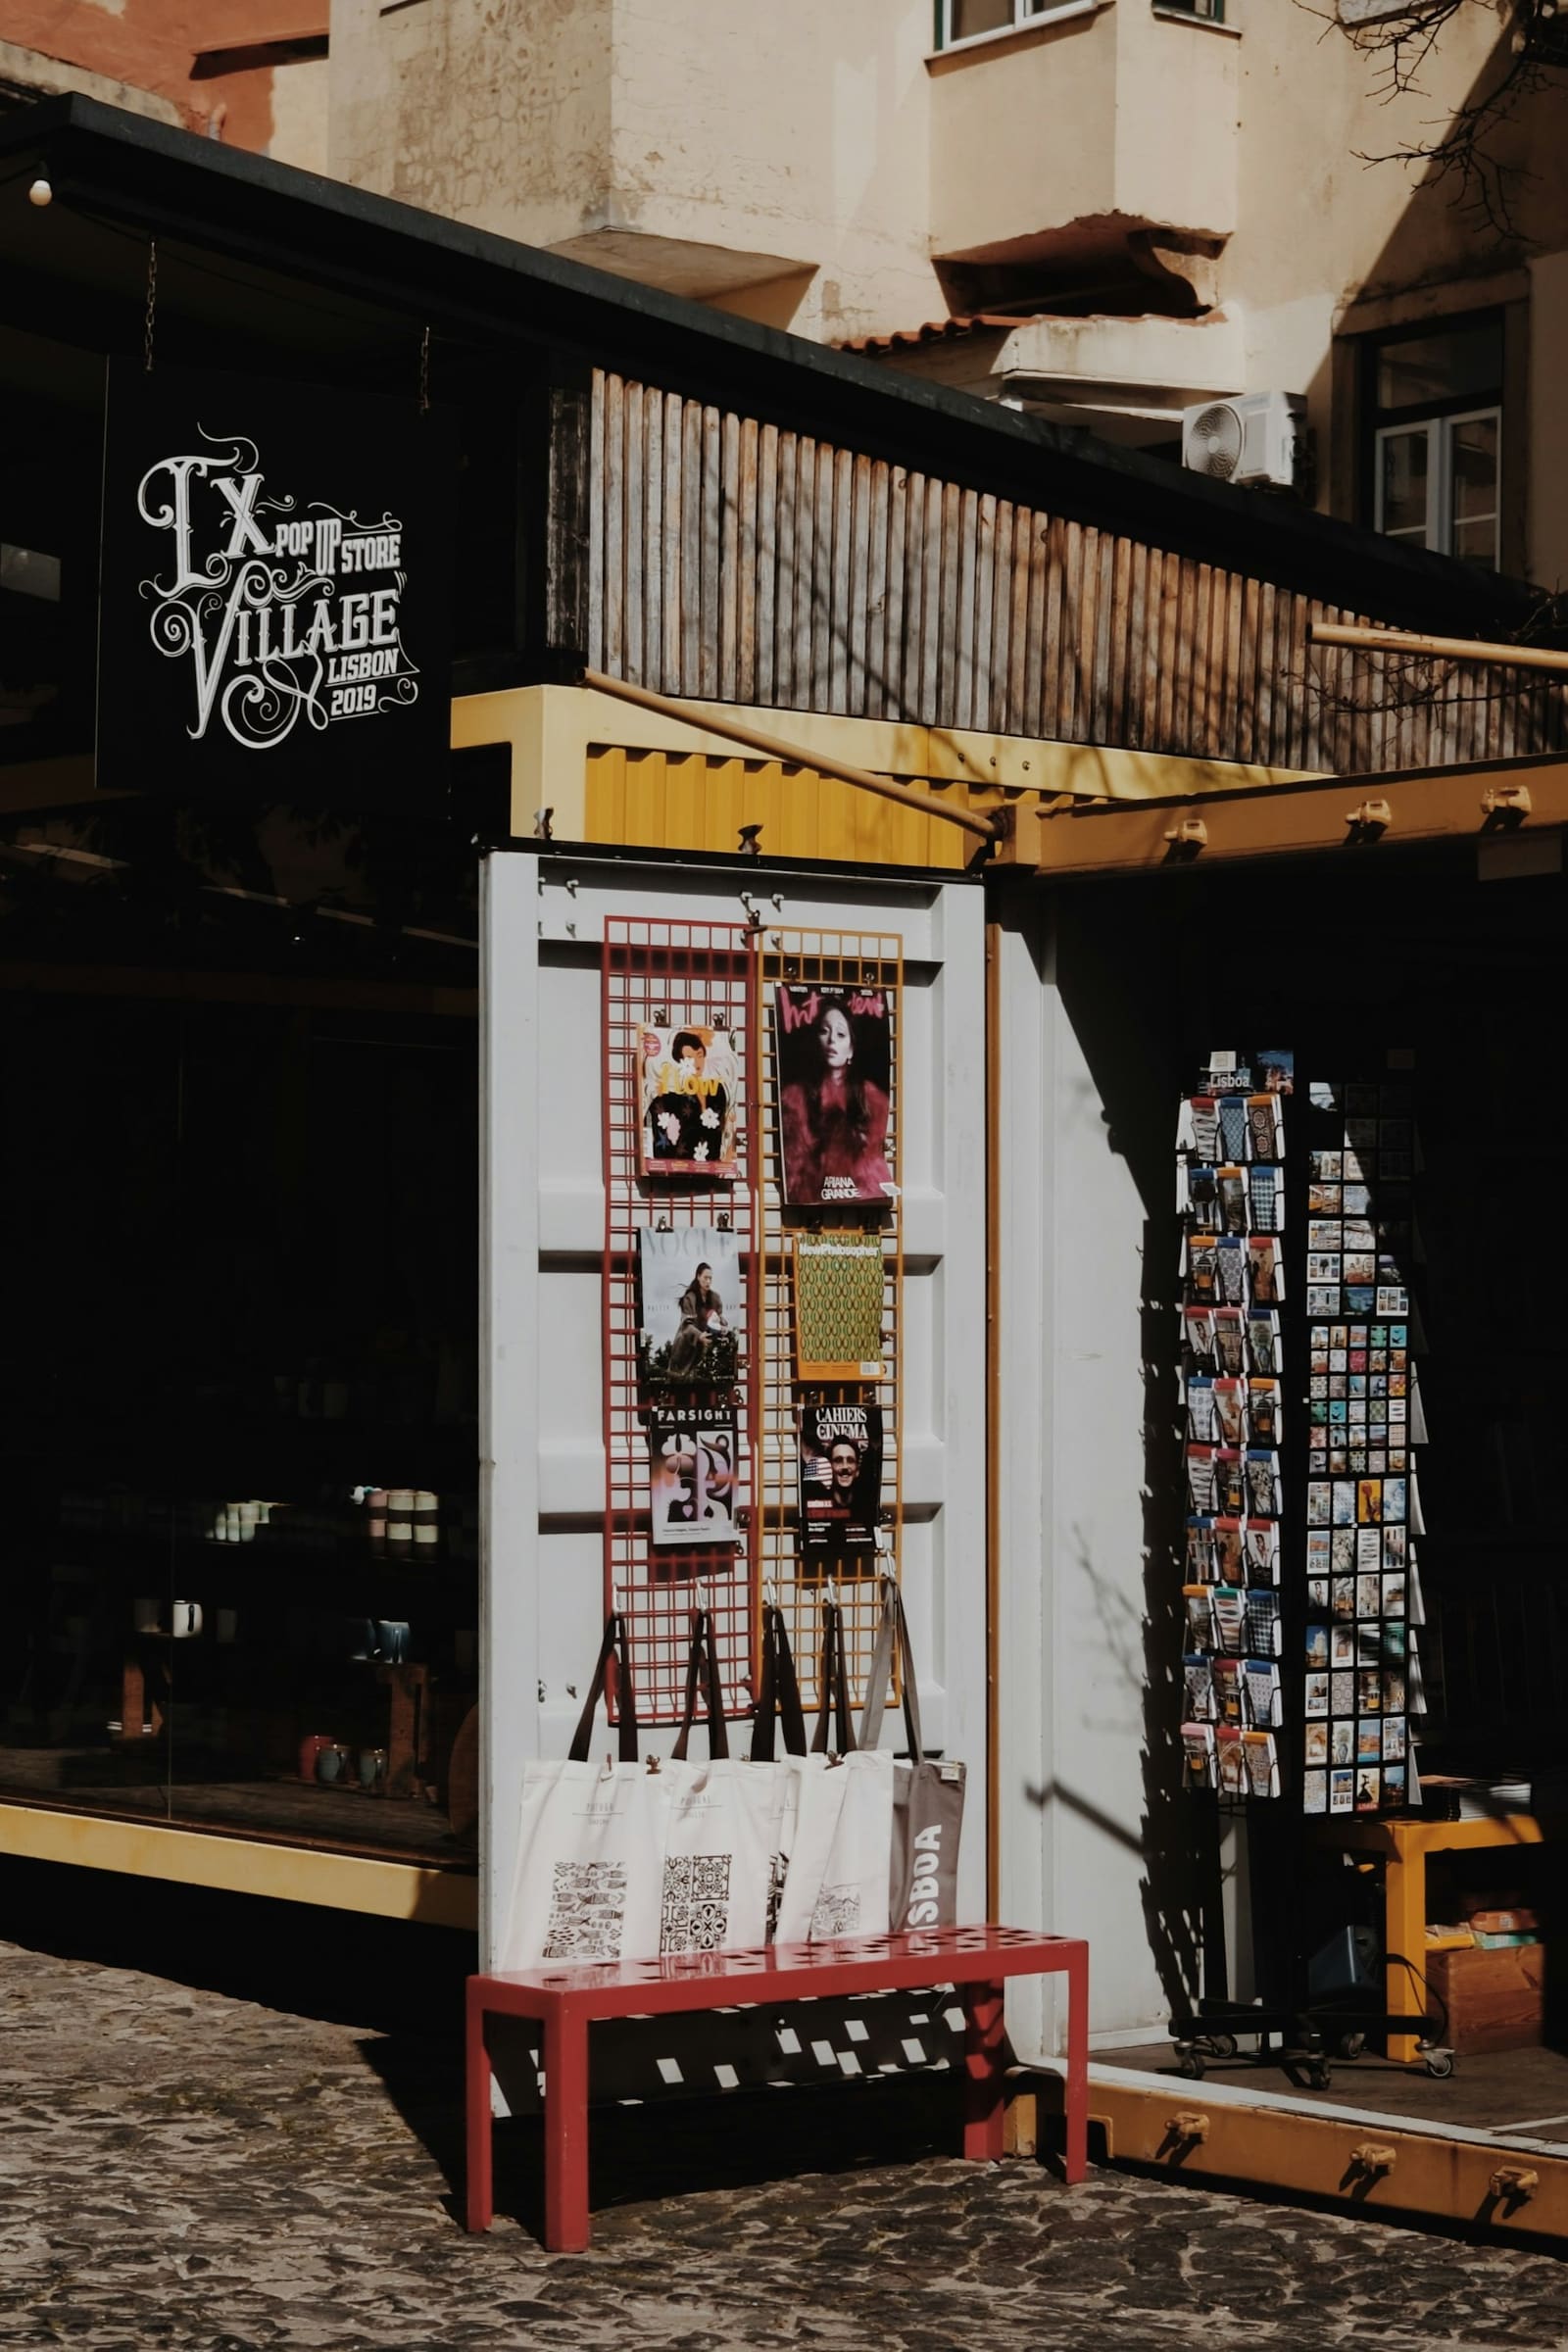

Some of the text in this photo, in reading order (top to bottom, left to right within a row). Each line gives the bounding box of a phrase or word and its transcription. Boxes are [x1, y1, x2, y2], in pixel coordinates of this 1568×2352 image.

[275, 518, 402, 576] POP UP STORE
[150, 561, 401, 739] VILLAGE
[327, 649, 400, 684] LISBON
[330, 684, 377, 715] 2019
[1210, 1072, 1250, 1089] Lisboa
[823, 1175, 856, 1188] ARIANA
[820, 1188, 862, 1200] GRANDE
[643, 1228, 735, 1258] VOGUE
[657, 1408, 732, 1422] FARSIGHT
[815, 1406, 868, 1424] CAHIERS
